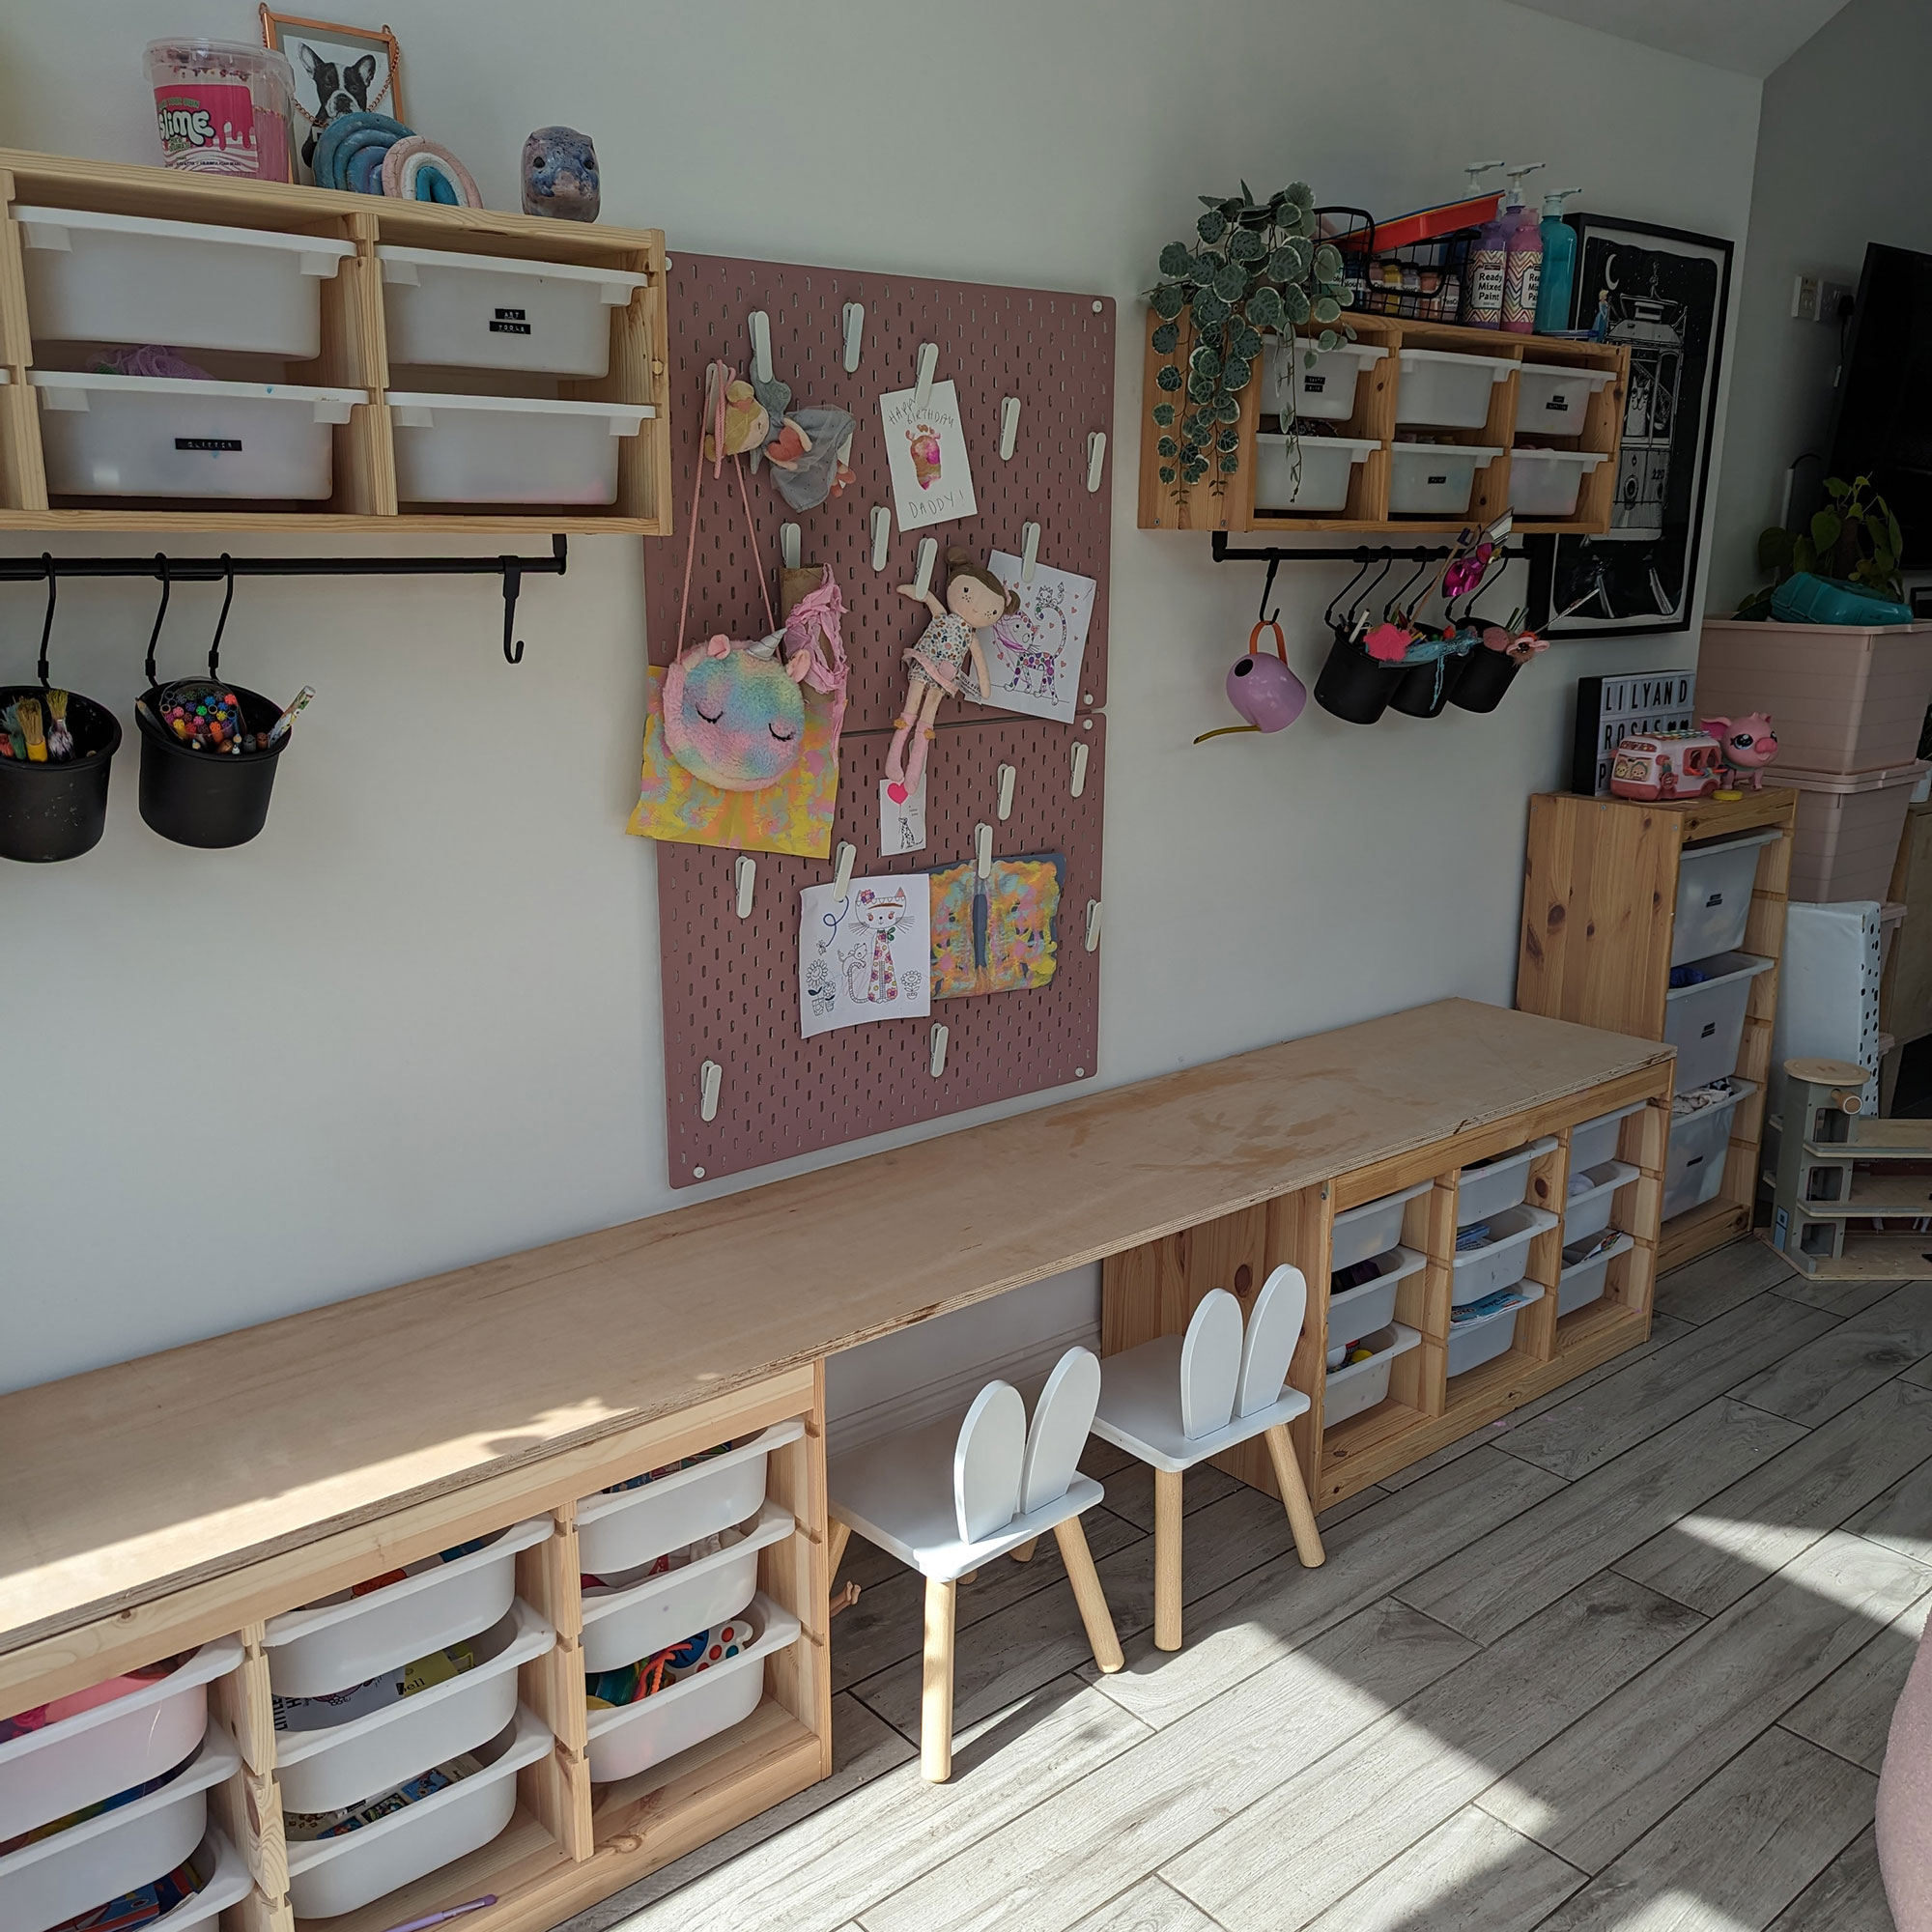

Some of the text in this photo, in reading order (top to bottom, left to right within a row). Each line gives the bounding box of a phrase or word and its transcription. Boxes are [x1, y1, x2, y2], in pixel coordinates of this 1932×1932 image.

[1479, 273, 1502, 283] Ready
[1478, 292, 1499, 300] Paint
[889, 398, 916, 425] HAPP
